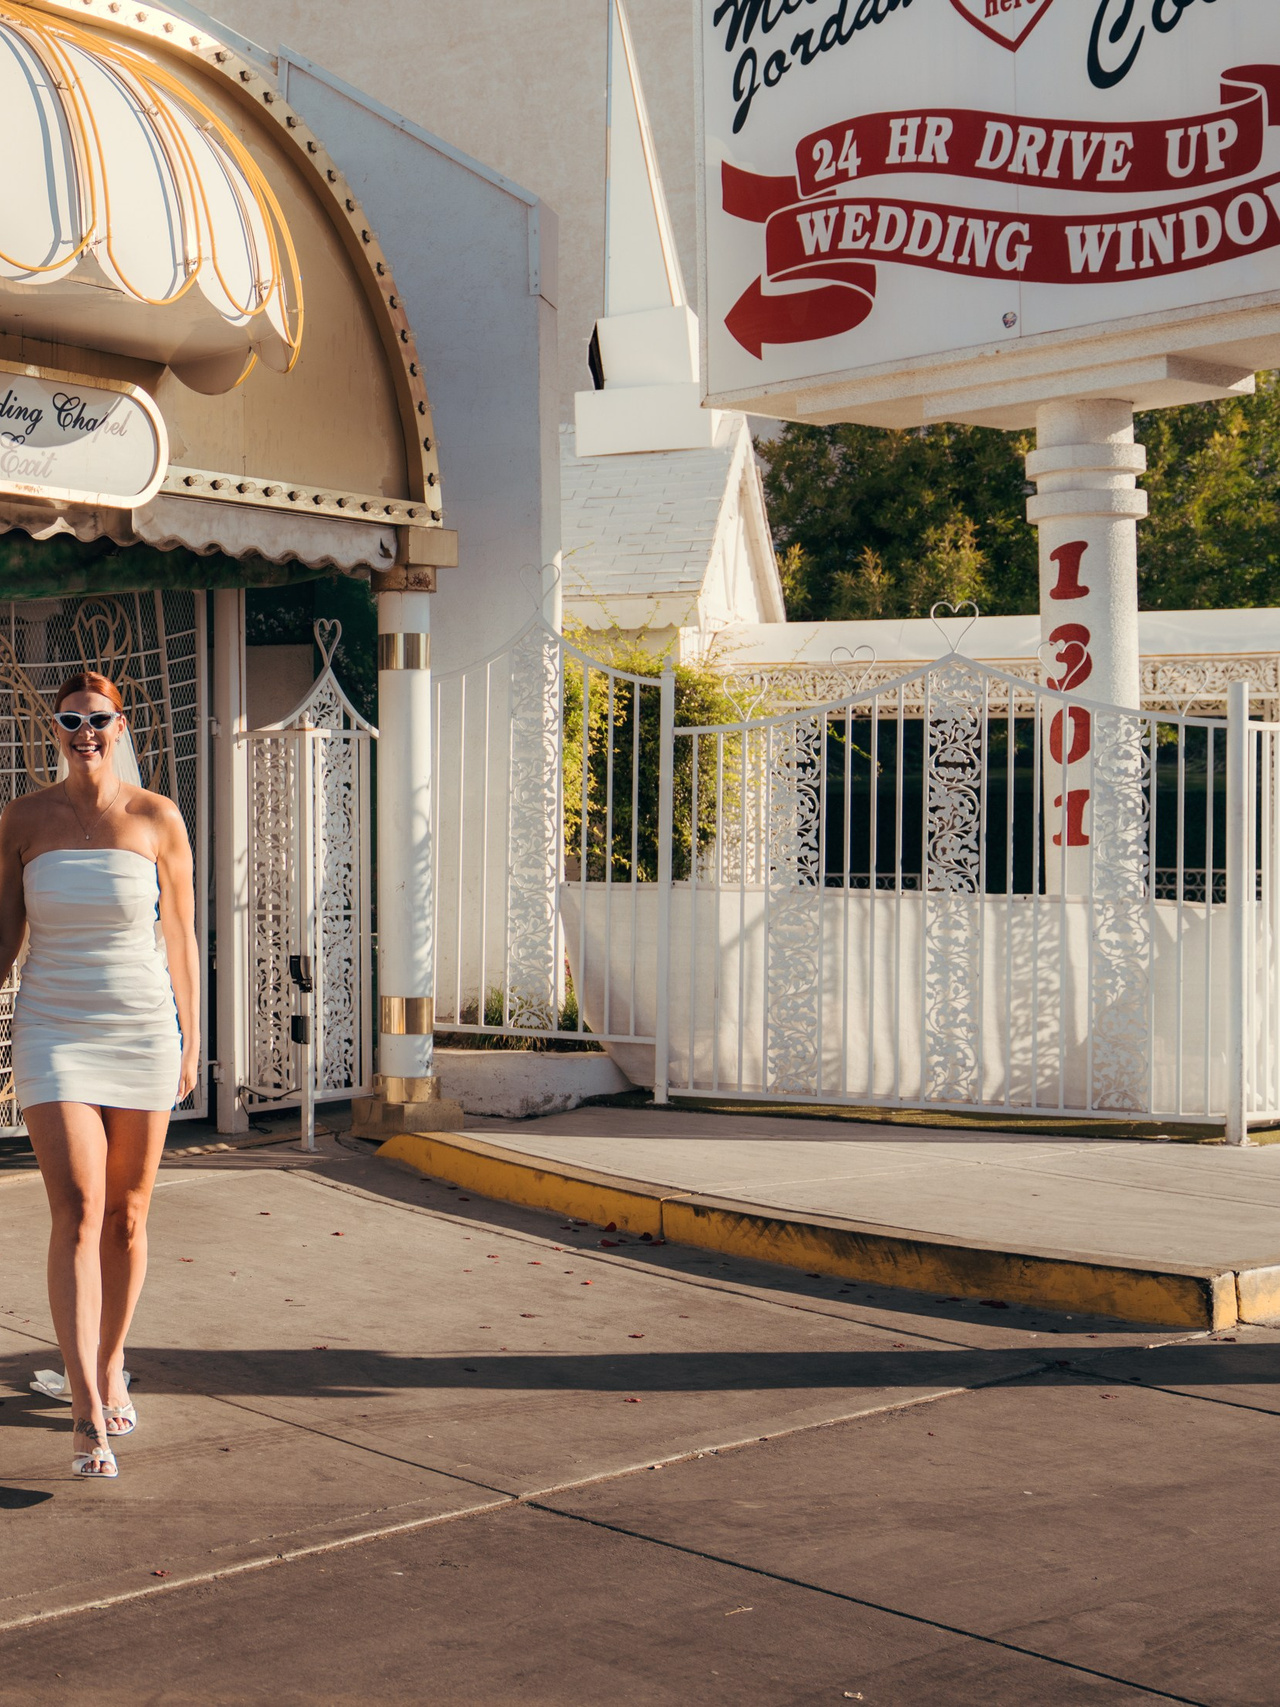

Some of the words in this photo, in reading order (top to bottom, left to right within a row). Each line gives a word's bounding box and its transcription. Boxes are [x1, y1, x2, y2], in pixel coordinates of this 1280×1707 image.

[812, 129, 861, 182] 24
[885, 116, 953, 164] HR
[974, 121, 1134, 182] DRIVE
[1165, 118, 1238, 178] UP
[796, 205, 1033, 271] WEDDING
[1065, 182, 1280, 273] WINDO
[52, 392, 128, 443] Chapel
[0, 431, 57, 478] Exit
[1046, 540, 1093, 846] 1301
